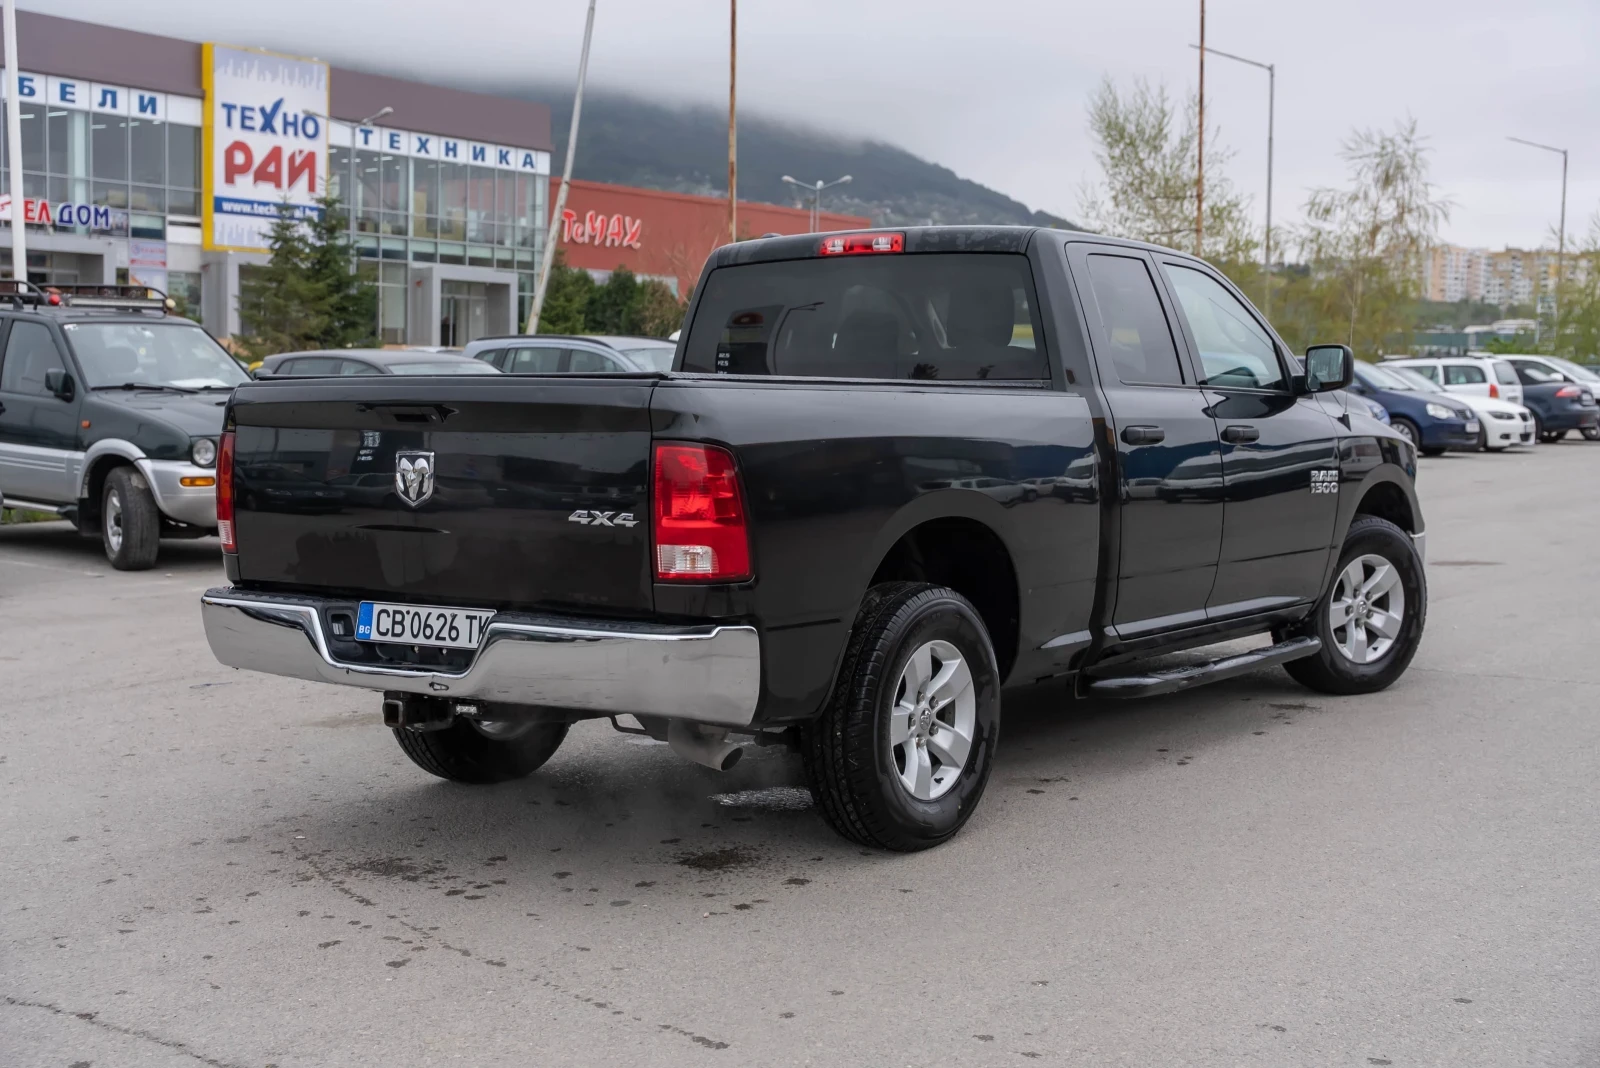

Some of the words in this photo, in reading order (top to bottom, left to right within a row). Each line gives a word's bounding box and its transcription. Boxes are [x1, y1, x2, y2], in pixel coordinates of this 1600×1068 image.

[221, 97, 320, 139] ТЕХНО
[359, 128, 535, 169] ТЕХНИКА
[224, 140, 316, 193] РАЙ
[58, 203, 110, 228] ДОМ
[1310, 470, 1339, 481] RAM
[1310, 482, 1339, 494] 1500
[358, 625, 371, 634] BG
[410, 611, 460, 642] 0626
